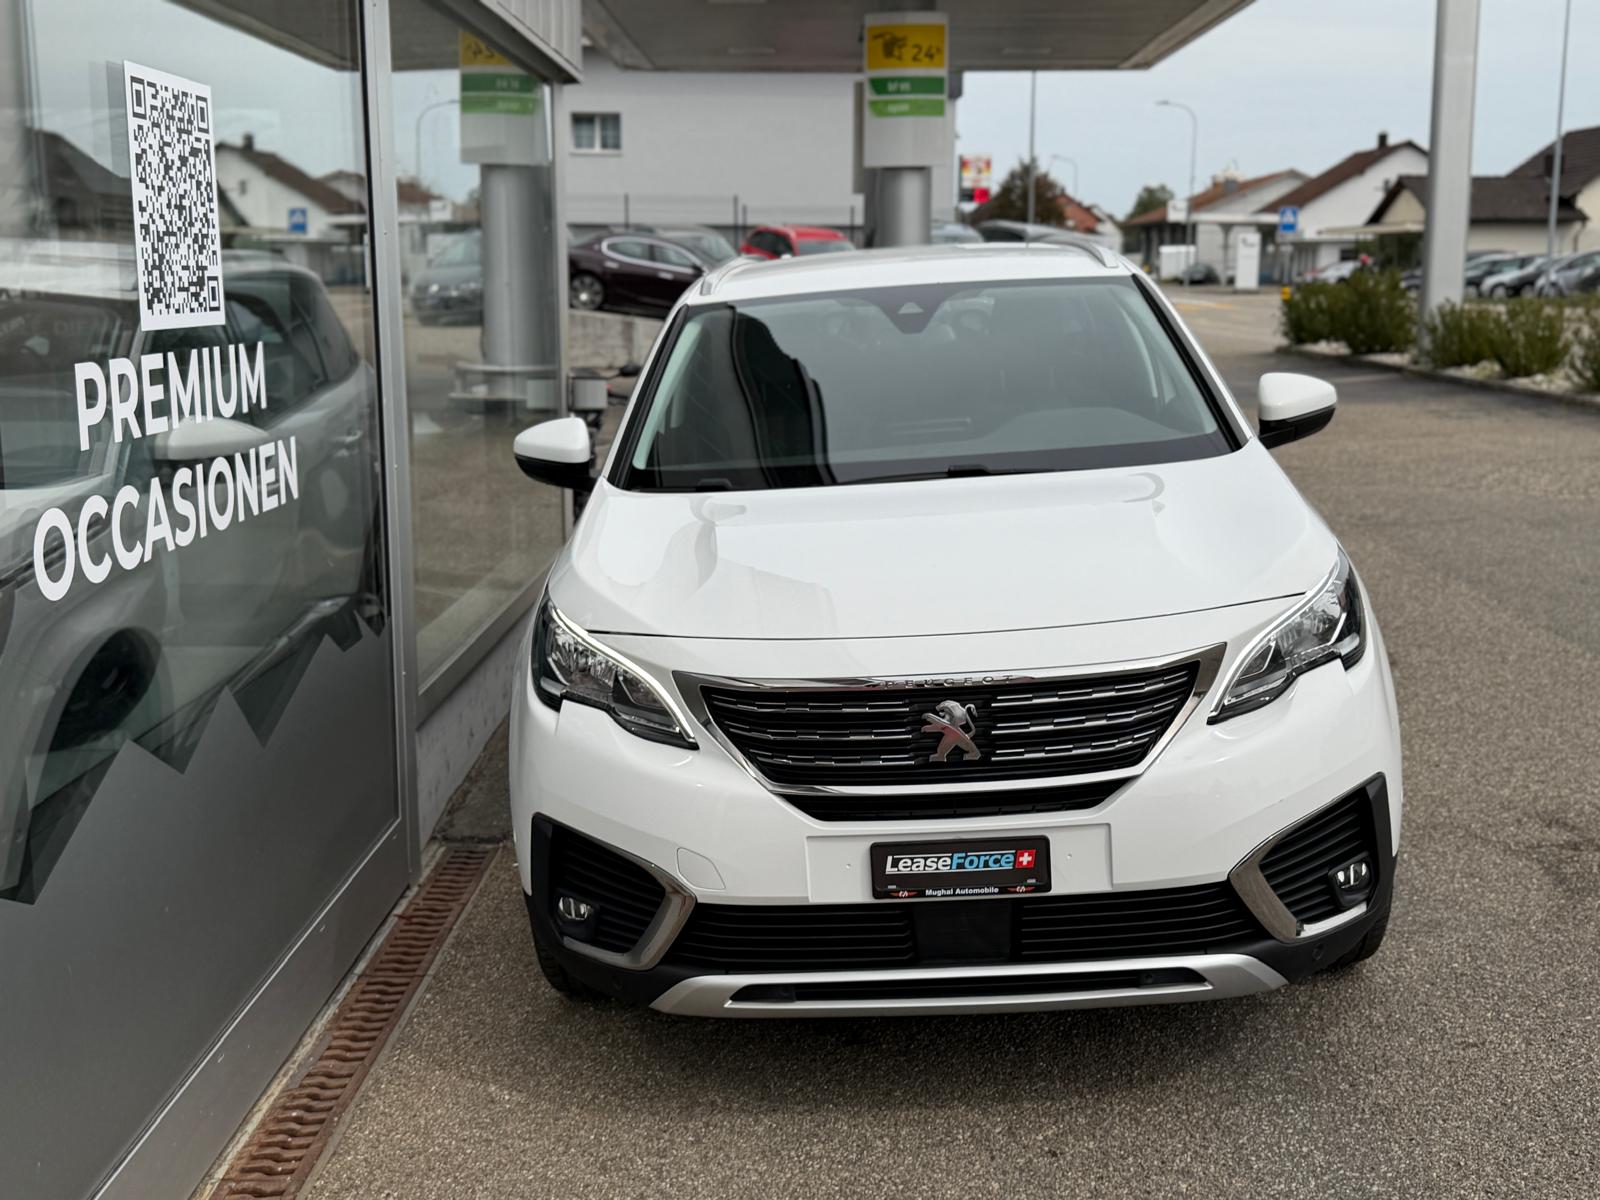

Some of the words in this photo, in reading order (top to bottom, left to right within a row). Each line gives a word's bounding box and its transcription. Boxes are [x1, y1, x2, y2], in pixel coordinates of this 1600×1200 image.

[74, 341, 267, 451] PREMIUM
[33, 436, 299, 601] OCCASIONEN
[885, 674, 1013, 689] PEUGEOT
[885, 850, 1015, 874] LeaseForce
[925, 889, 954, 897] Mughal
[955, 887, 999, 896] Automobile
